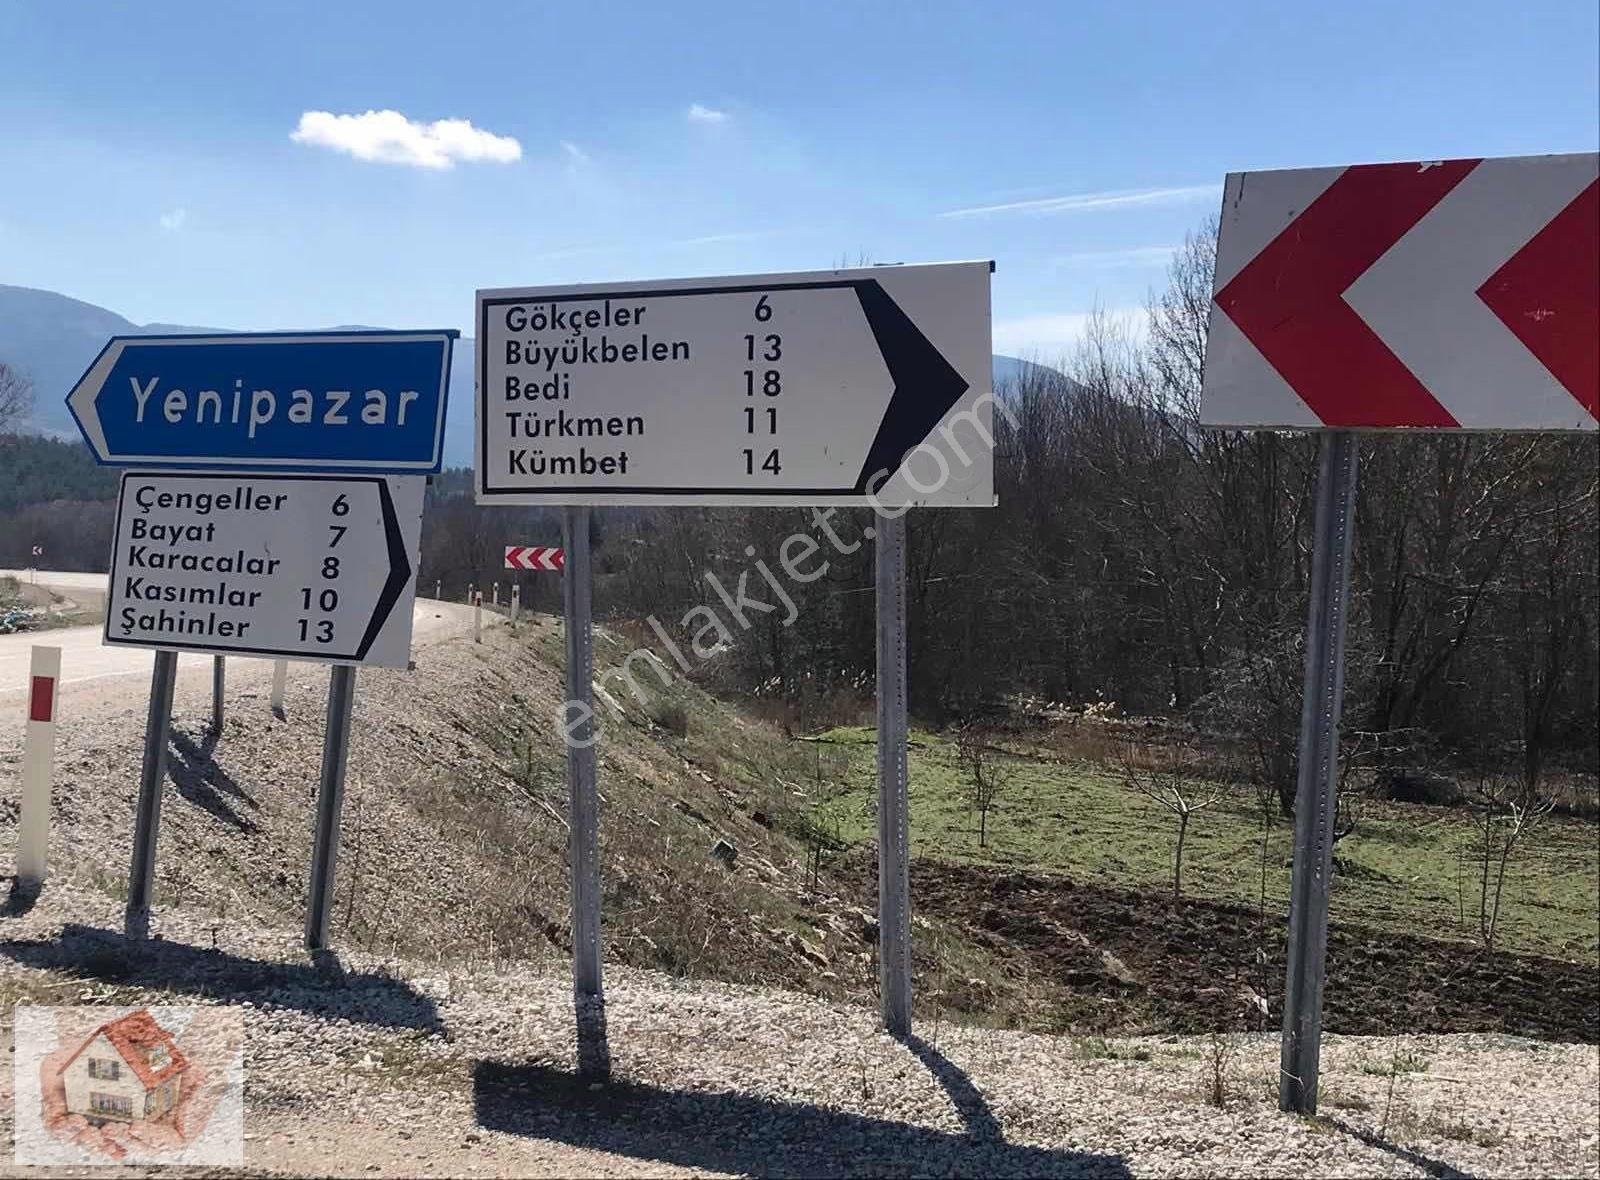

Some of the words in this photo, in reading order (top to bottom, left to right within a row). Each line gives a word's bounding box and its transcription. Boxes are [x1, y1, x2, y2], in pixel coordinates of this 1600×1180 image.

[505, 301, 647, 336] Gökçeler
[754, 295, 773, 323] 6
[505, 335, 691, 371] Büyükbelen
[743, 334, 782, 362] 13
[505, 372, 570, 401] Bedi
[743, 369, 782, 397] 18
[129, 376, 419, 438] Yenipazar
[506, 410, 645, 438] Türkmen
[743, 407, 778, 435] 11
[508, 449, 629, 476] Kümbet
[742, 448, 782, 476] 14
[135, 485, 288, 514] Çengeller
[331, 493, 351, 517] 6
[131, 518, 215, 547] Bayat
[328, 525, 348, 548] 7
[128, 545, 281, 576] Karacalar
[321, 556, 340, 580] 8
[124, 576, 261, 608] Kasımlar
[300, 587, 339, 612] 10
[120, 607, 251, 638] Şahinler
[297, 618, 335, 644] 13
